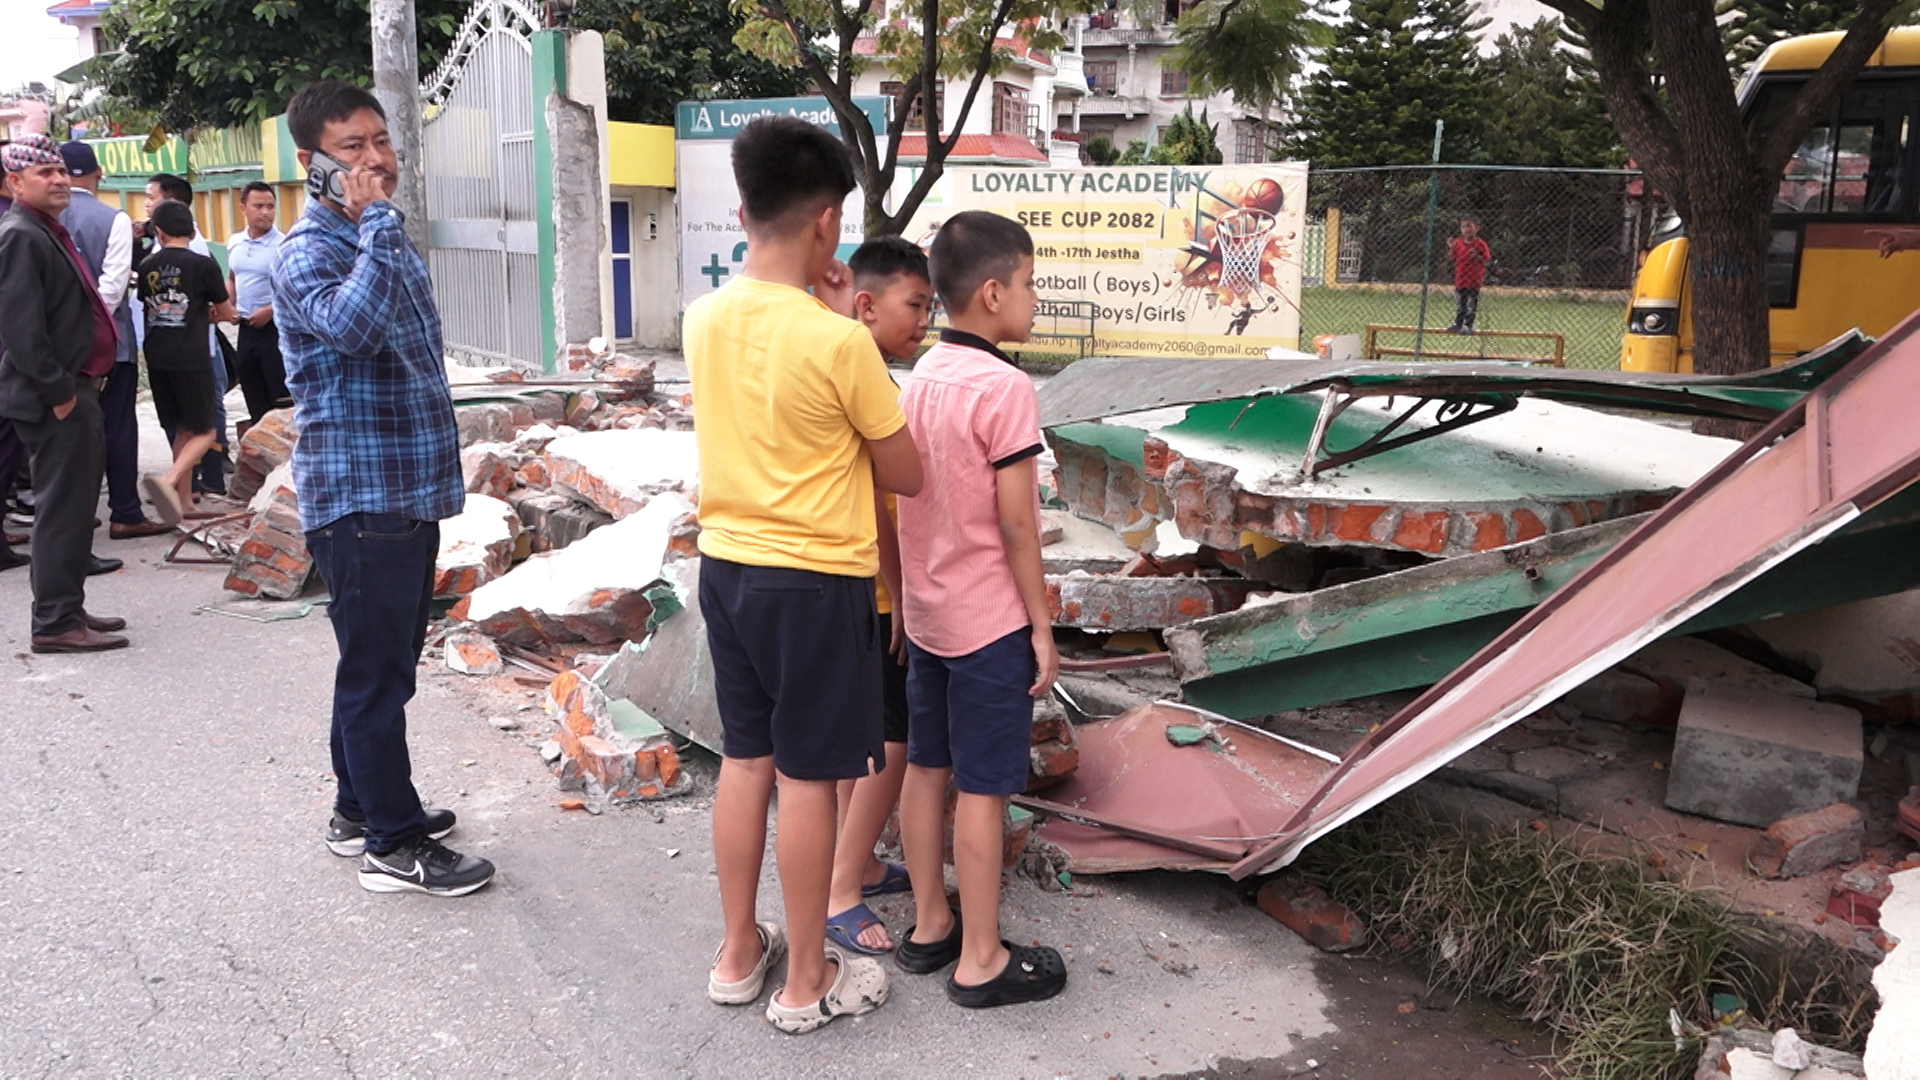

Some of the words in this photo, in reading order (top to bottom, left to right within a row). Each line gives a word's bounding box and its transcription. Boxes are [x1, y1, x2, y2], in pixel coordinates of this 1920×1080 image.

[972, 172, 1075, 193] LOYALTY
[1080, 170, 1212, 193] ACADEMY
[687, 222, 703, 232] For
[705, 222, 723, 232] The
[1017, 211, 1053, 227] SEE
[1061, 211, 1102, 228] CUP
[1107, 212, 1155, 229] 2082
[1095, 247, 1140, 260] Jestha
[1034, 274, 1087, 290] otball
